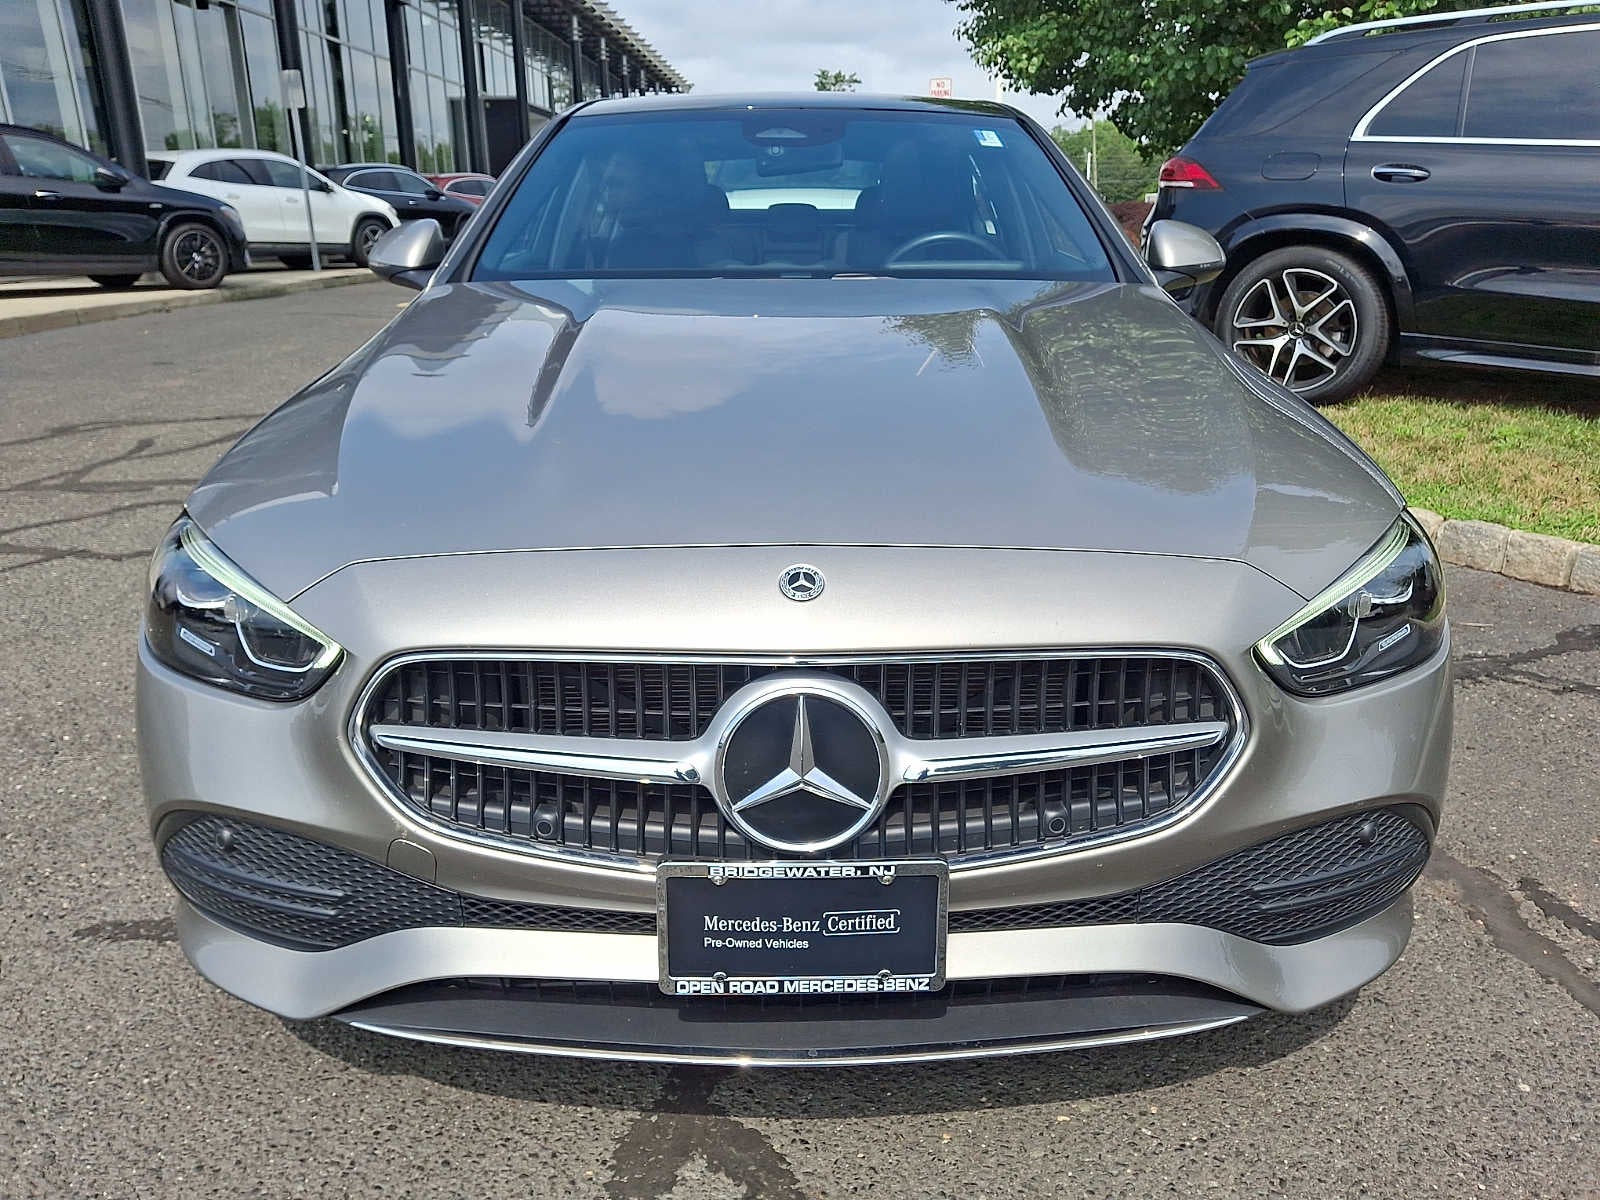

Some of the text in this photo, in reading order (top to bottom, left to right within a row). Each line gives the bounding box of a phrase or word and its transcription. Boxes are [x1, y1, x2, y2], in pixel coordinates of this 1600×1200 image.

[708, 866, 896, 877] BRIDGEWATER, NJ
[704, 913, 895, 932] Mercedes-Benz Certified
[704, 937, 809, 949] Pre-Owned Vehicles
[676, 980, 724, 994] OPEN
[729, 980, 779, 993] ROAD
